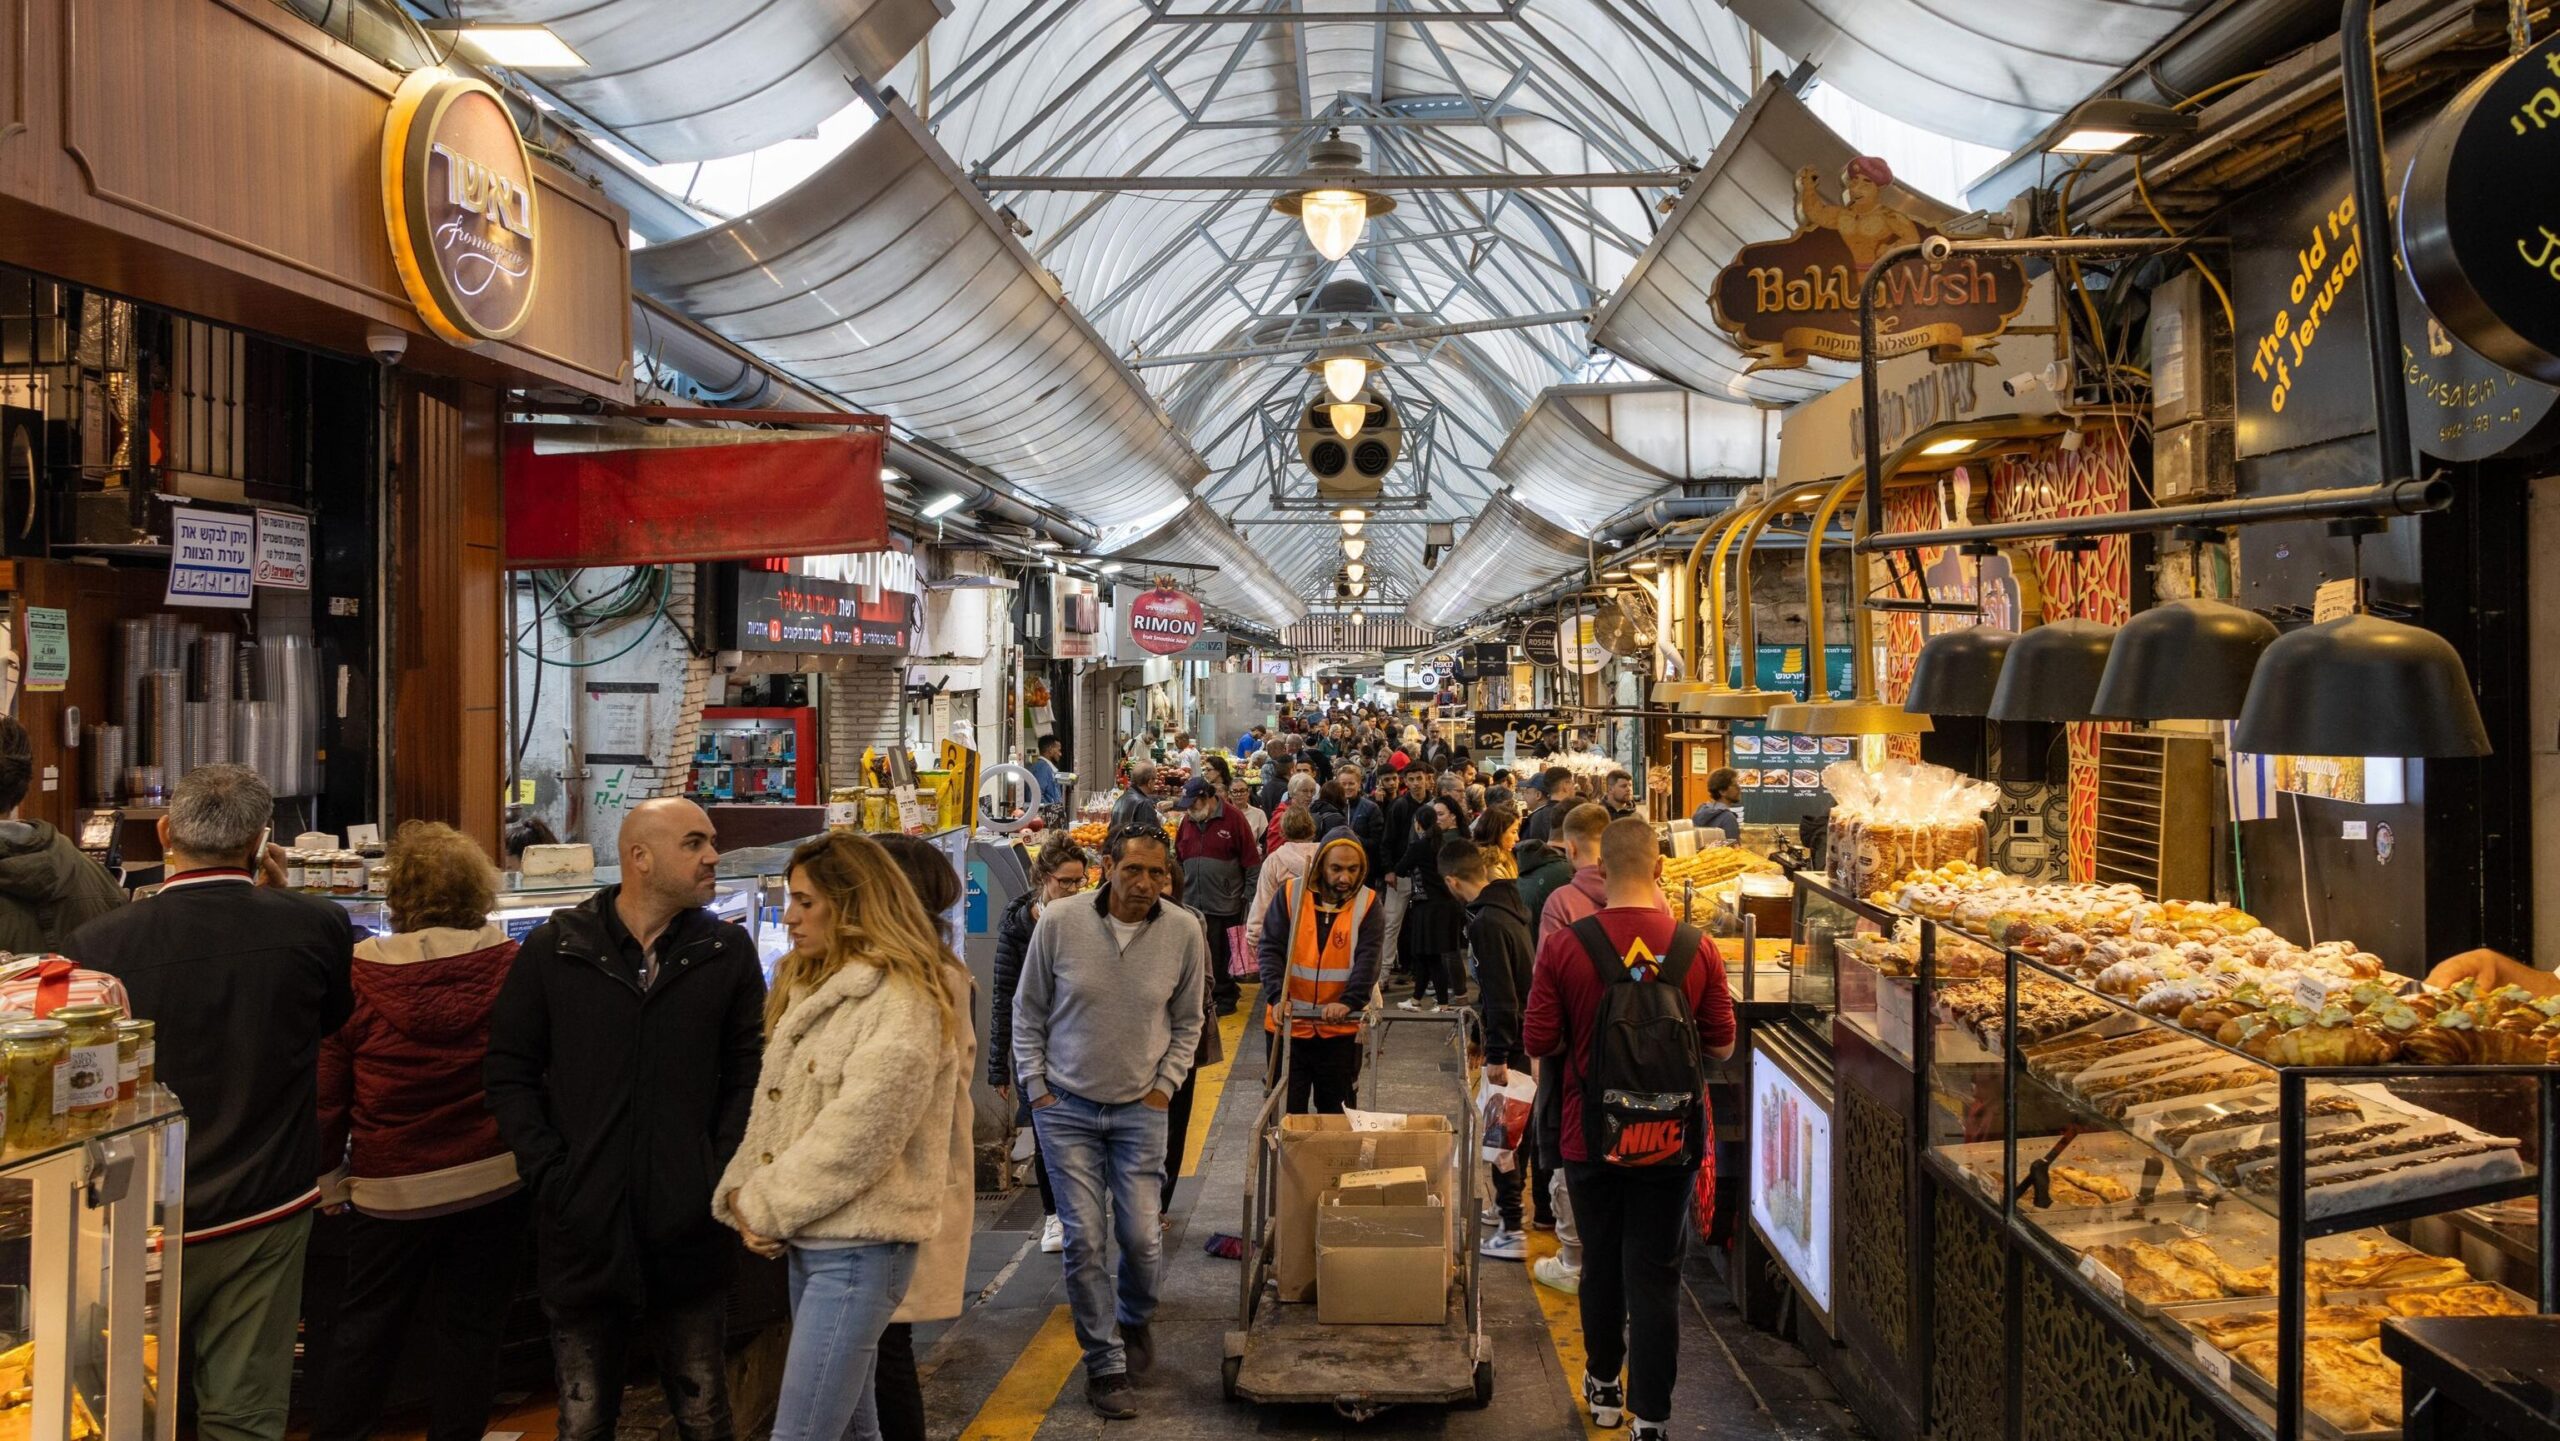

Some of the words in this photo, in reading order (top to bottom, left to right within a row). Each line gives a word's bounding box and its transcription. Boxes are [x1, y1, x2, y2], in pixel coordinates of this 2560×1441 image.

[433, 142, 535, 240] באשר
[2252, 310, 2290, 382] The
[2291, 225, 2327, 305] old
[2271, 356, 2292, 413] of
[2289, 223, 2364, 368] Jerusal
[181, 525, 196, 540] את
[200, 525, 227, 544] לבקש
[230, 530, 248, 546] ניתן
[182, 546, 213, 560] הצוות
[217, 548, 245, 564] עזרת
[862, 551, 916, 604] מחסן
[839, 598, 856, 618] רשת
[1133, 614, 1196, 635] RIMON
[1567, 646, 1602, 657] קיורוש
[1618, 1120, 1681, 1156] NIKE
